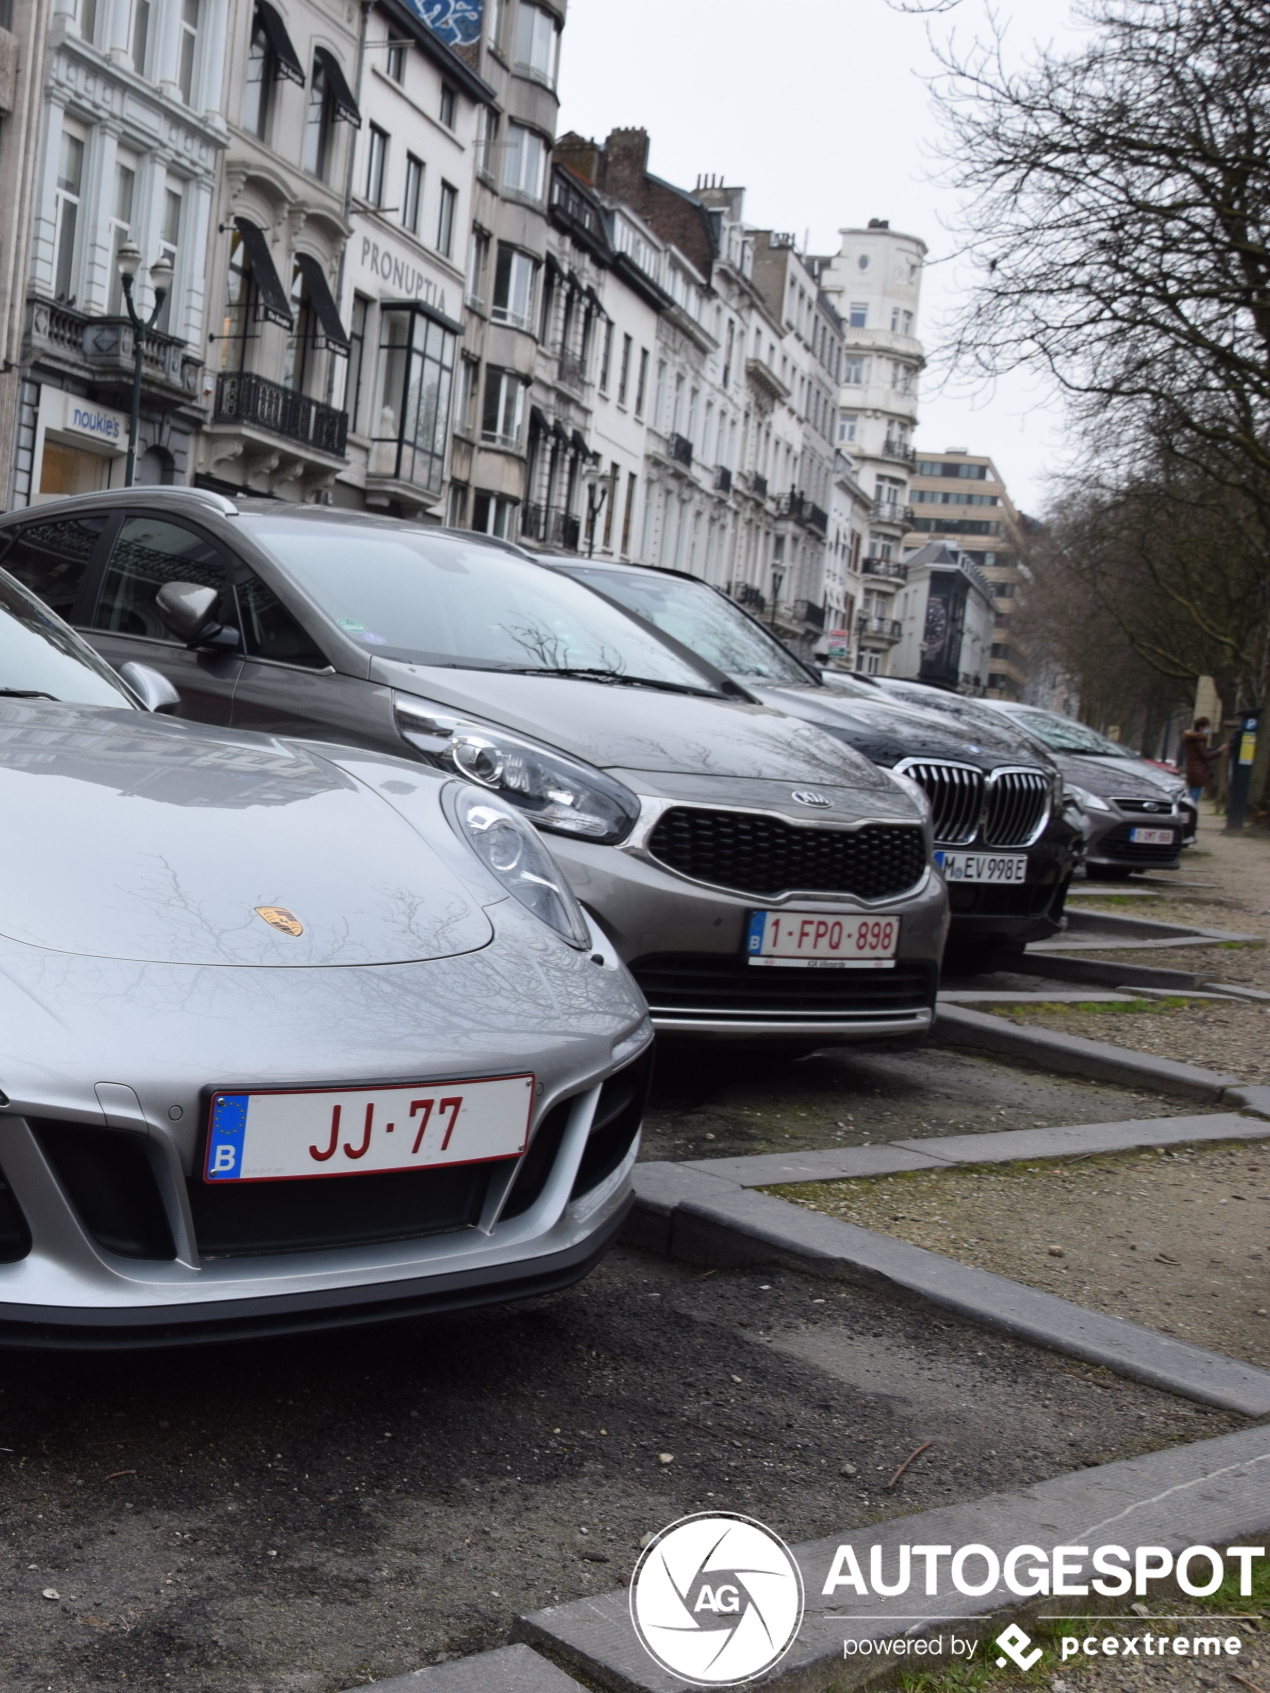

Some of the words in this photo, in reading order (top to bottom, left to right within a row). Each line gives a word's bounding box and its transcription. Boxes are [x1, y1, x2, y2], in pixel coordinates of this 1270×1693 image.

[361, 236, 446, 315] PRONUPTIA
[73, 409, 119, 438] noukie's
[749, 936, 761, 950] B
[771, 918, 894, 951] 1-FPQ-898
[215, 1145, 236, 1172] B
